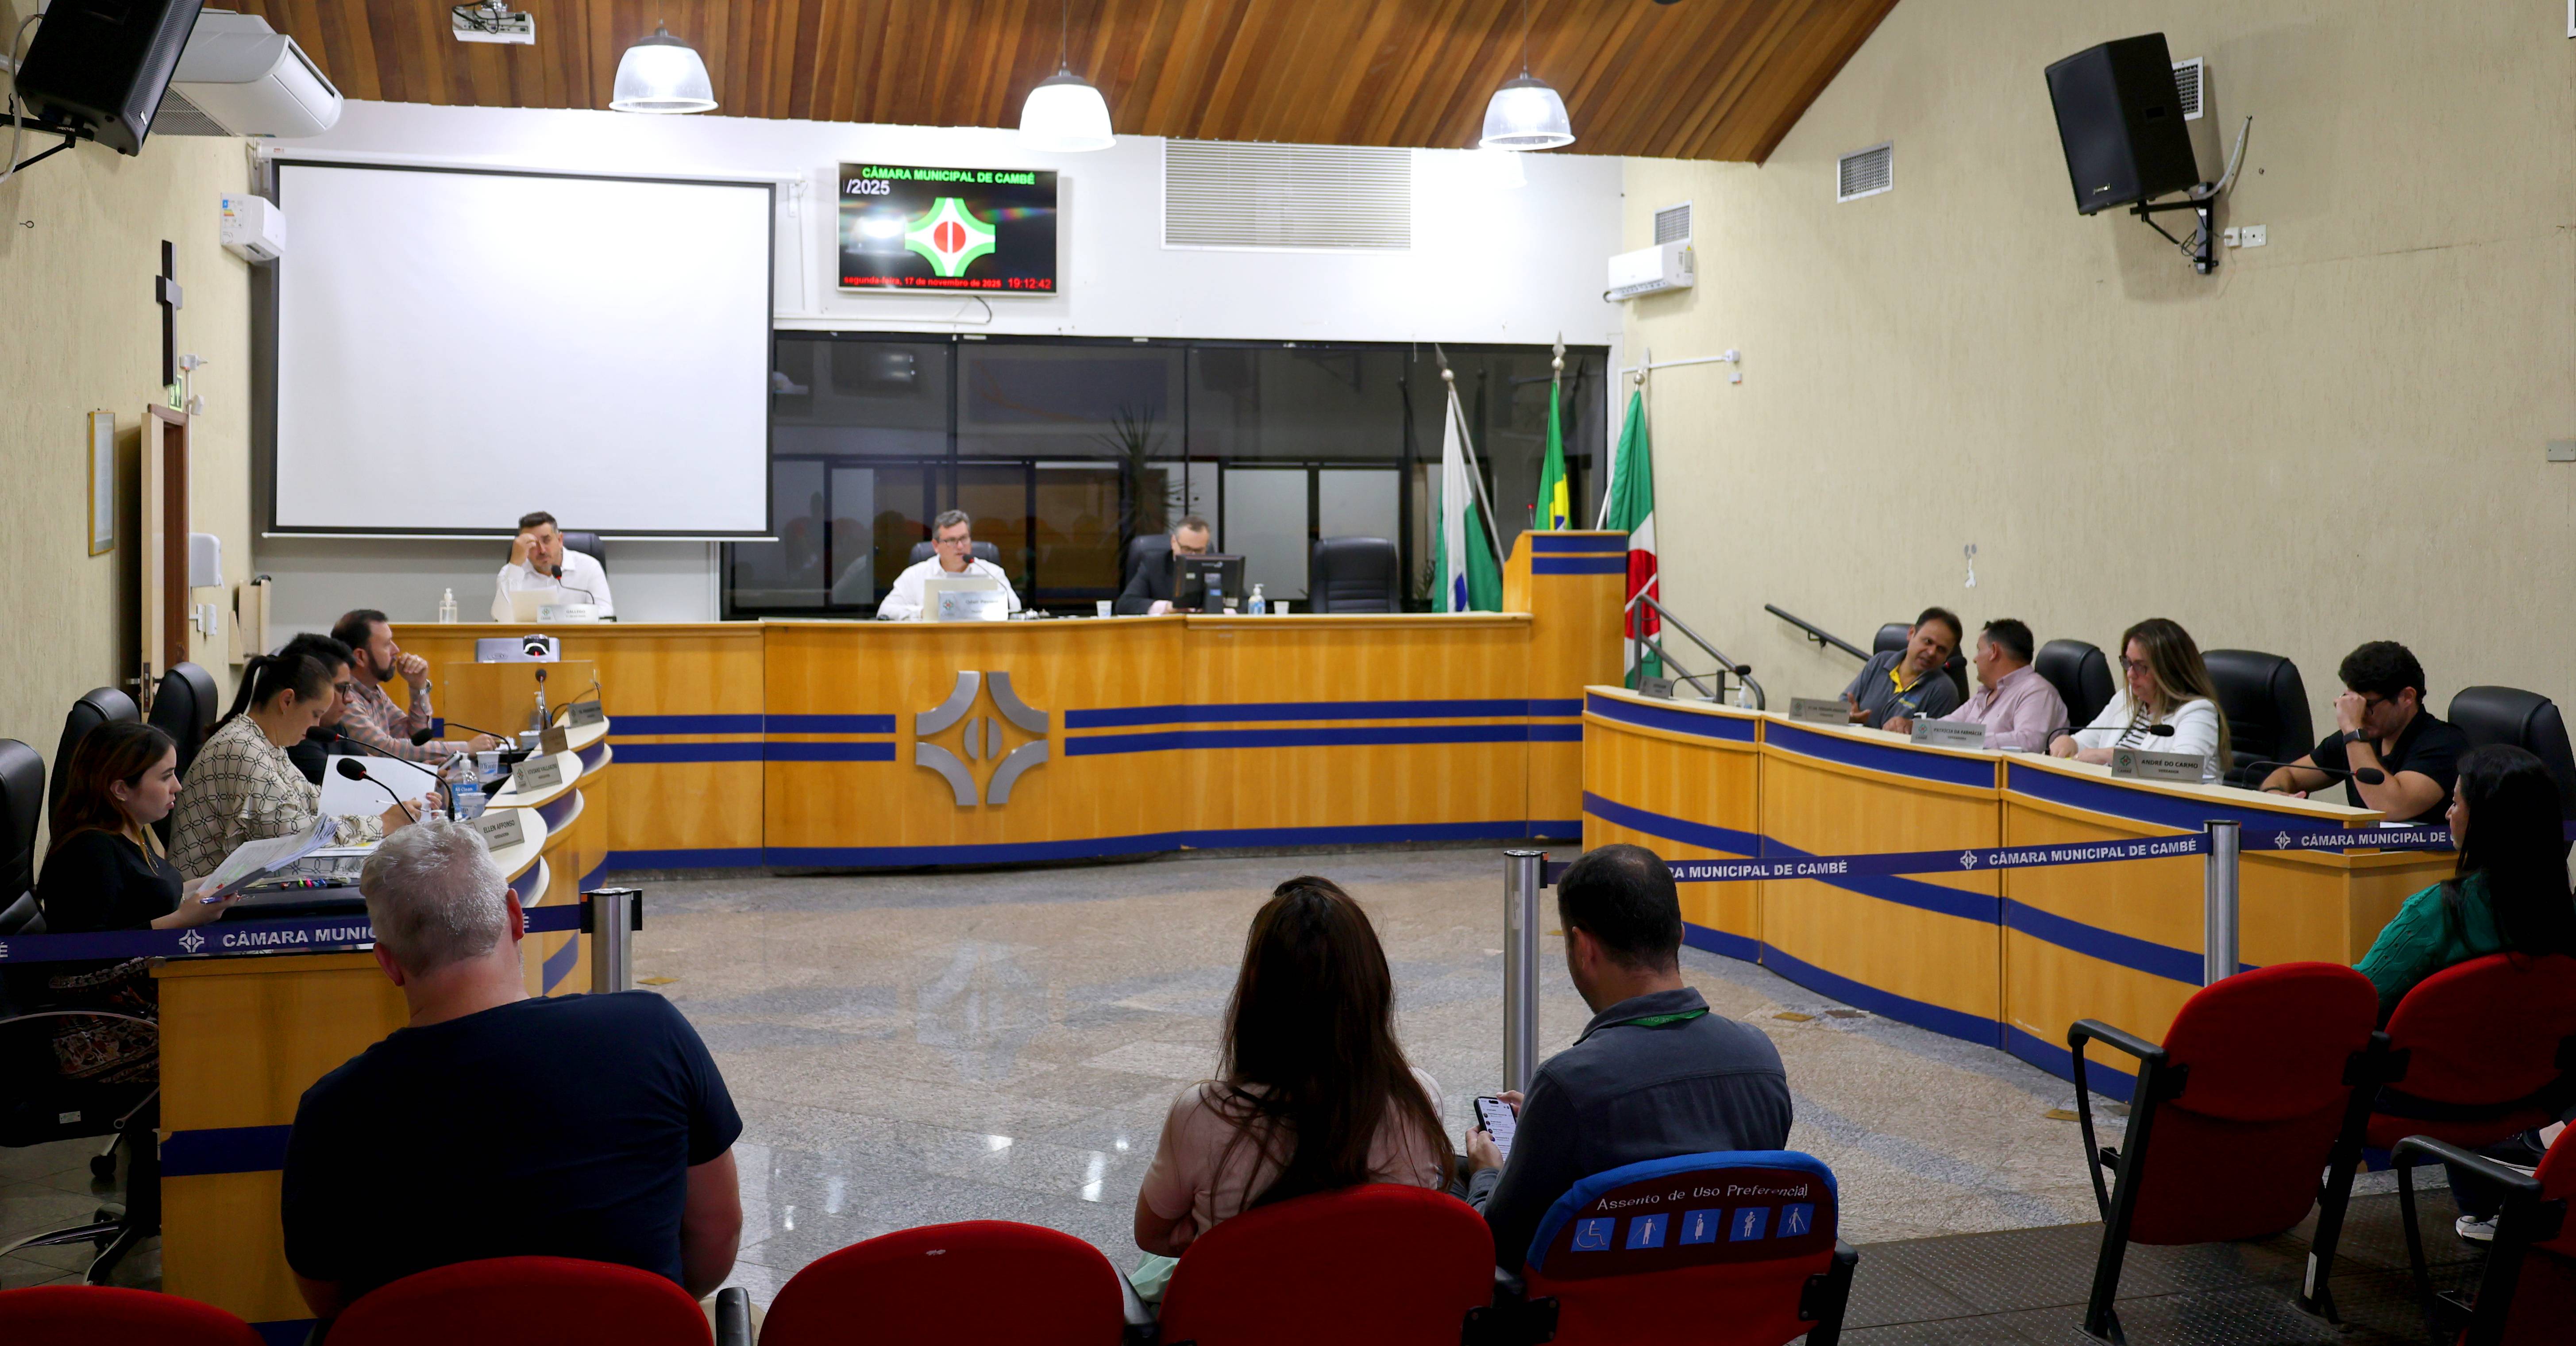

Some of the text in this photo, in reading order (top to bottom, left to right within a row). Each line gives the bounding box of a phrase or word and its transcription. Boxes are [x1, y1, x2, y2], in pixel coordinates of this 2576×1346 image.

[863, 165, 1035, 185] CÂMARA MUNICIPAL DE CAMBÉ
[844, 276, 902, 285] segunda-feira,
[928, 278, 968, 287] novembro
[982, 279, 1002, 288] 2025
[1008, 278, 1052, 289] 19:12:42
[483, 819, 515, 833] ELLEN AFFONSO
[2302, 834, 2354, 846] CÂMARA
[2359, 832, 2426, 844] MUNICIPAL
[2430, 832, 2446, 842] DE
[1989, 838, 2196, 865] CÂMARA MUNICIPAL DE CAMBÉ
[1689, 865, 1770, 878] MUNICIPAL
[1774, 864, 1793, 875] DE
[1797, 860, 1847, 874] CAMBÉ
[222, 927, 376, 947] CÂMARA MUNIC
[1597, 1184, 1808, 1210] Assento de Uso Preferencial
